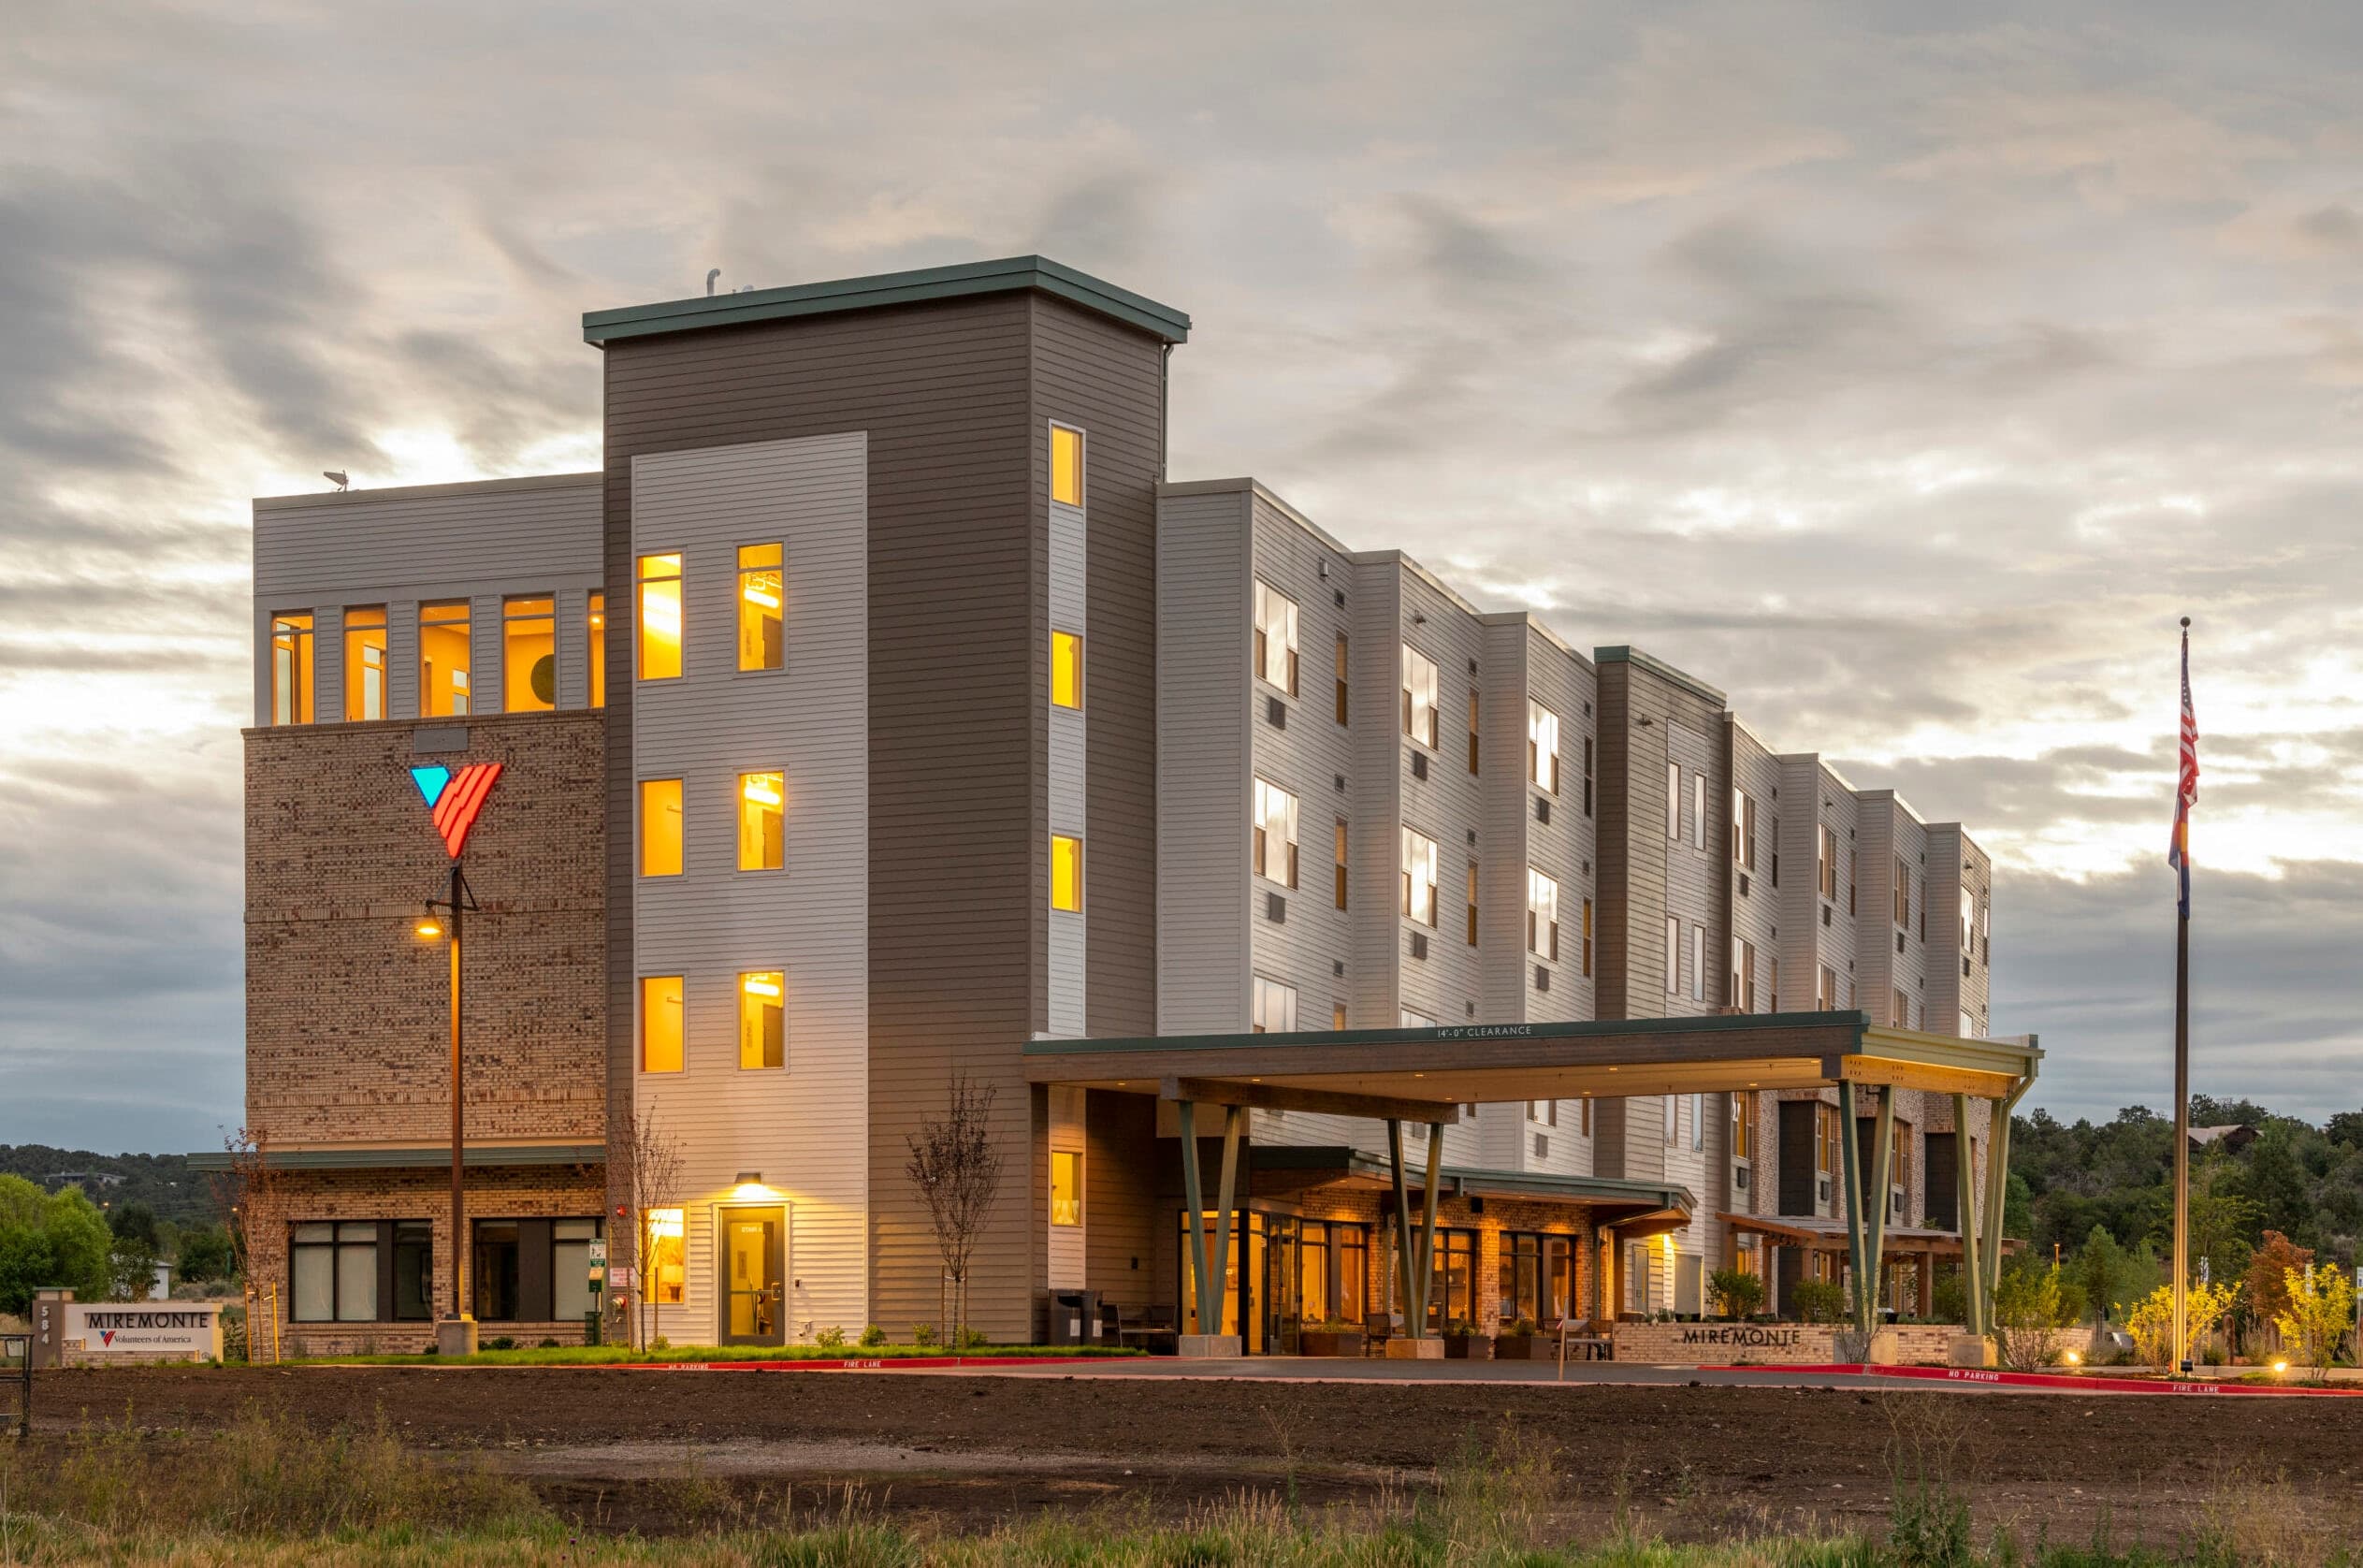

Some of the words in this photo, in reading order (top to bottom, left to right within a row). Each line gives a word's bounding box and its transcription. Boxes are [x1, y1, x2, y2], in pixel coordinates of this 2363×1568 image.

[1467, 1025, 1531, 1037] CLEARANCE
[41, 1305, 50, 1344] 584
[88, 1313, 208, 1328] MIREMONTE
[113, 1335, 152, 1343] Volunteers
[153, 1335, 160, 1343] of
[162, 1335, 191, 1343] America
[1683, 1329, 1800, 1345] MIREMONTE
[1964, 1371, 1998, 1381] PARKING
[2197, 1385, 2219, 1393] LANE
